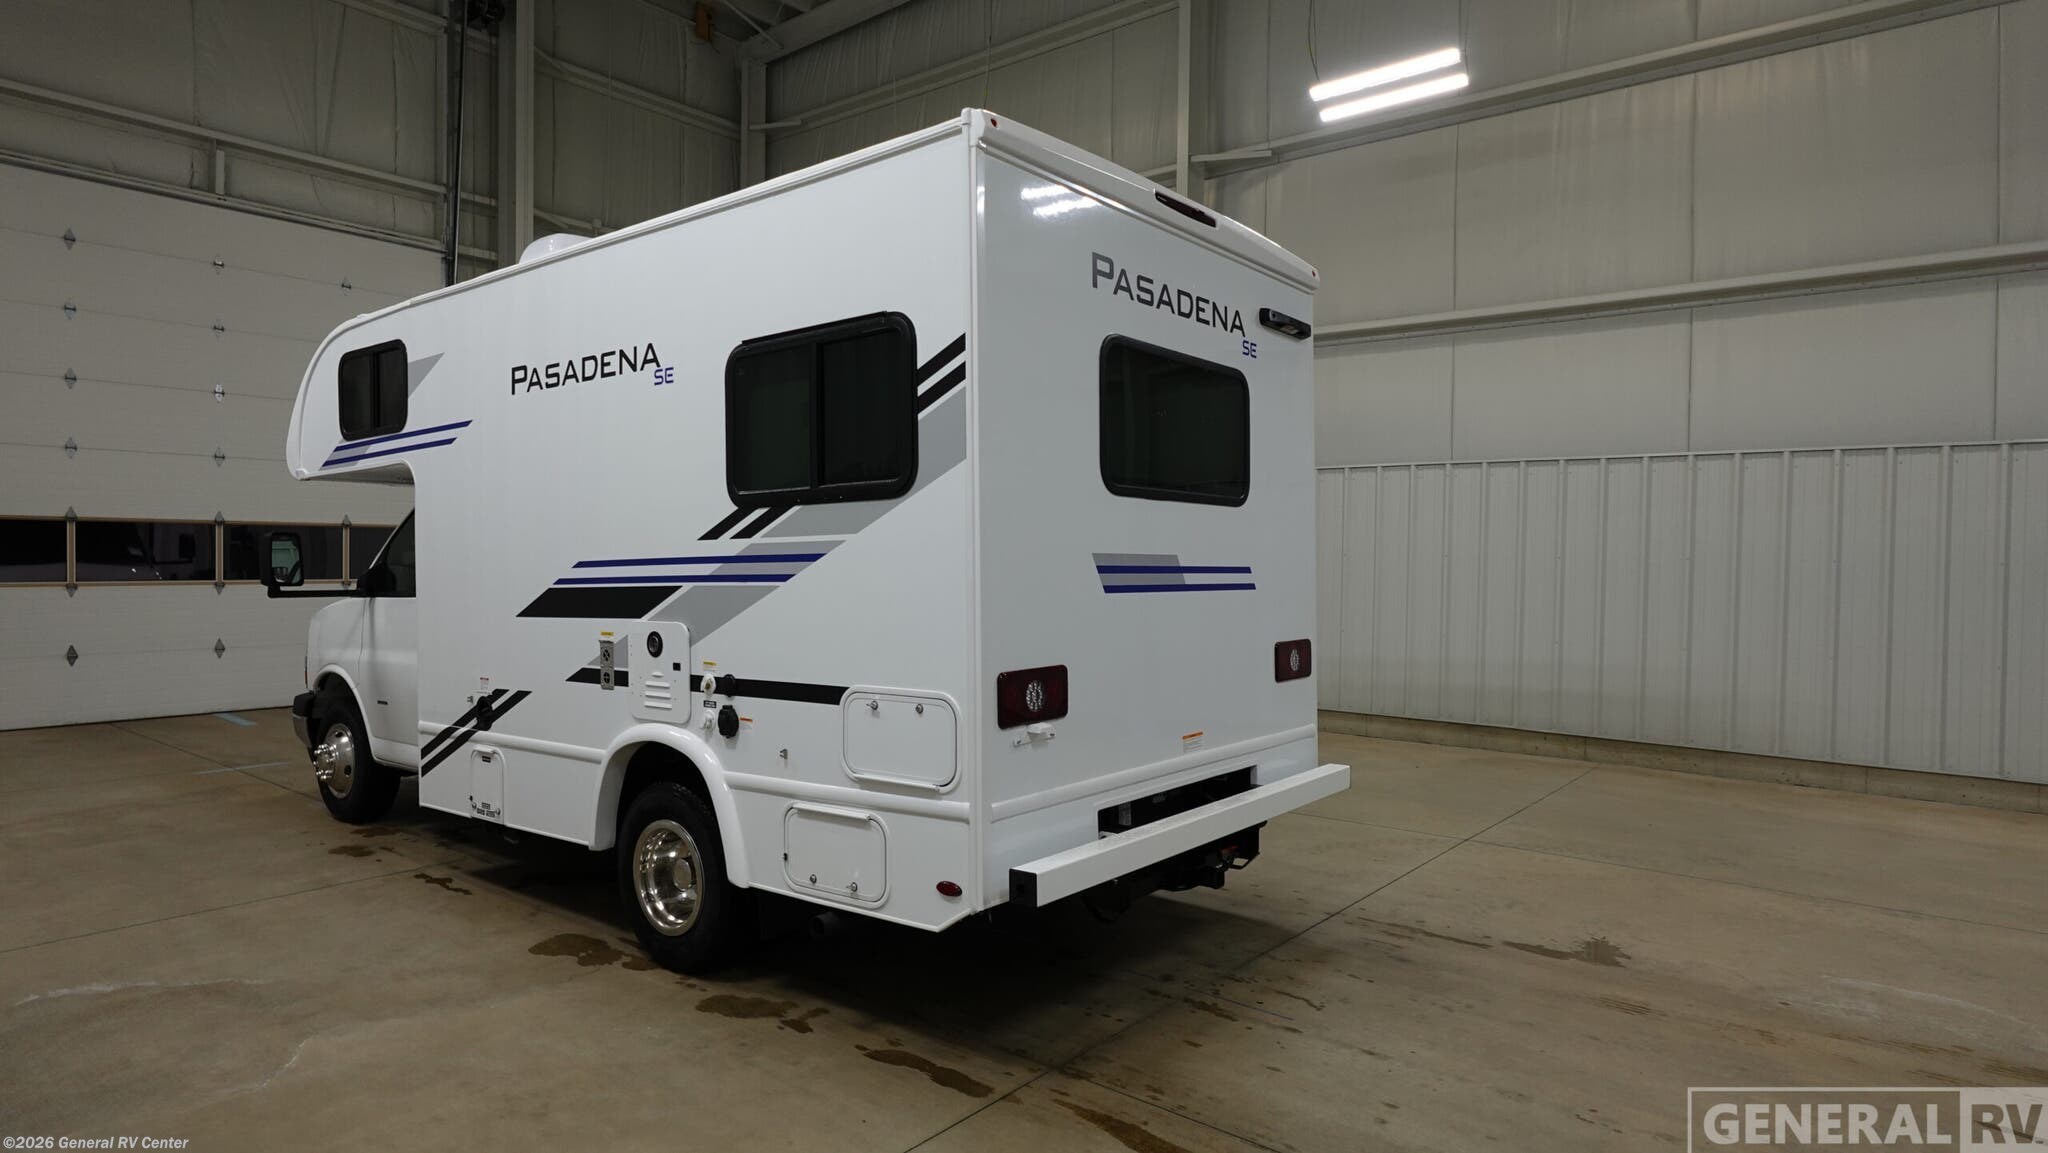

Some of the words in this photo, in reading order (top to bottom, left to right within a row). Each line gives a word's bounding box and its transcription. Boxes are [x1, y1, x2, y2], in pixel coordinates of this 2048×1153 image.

[1092, 251, 1246, 338] PASADENA
[1242, 340, 1257, 359] SE
[511, 342, 661, 395] PASADENA
[654, 367, 674, 386] SE
